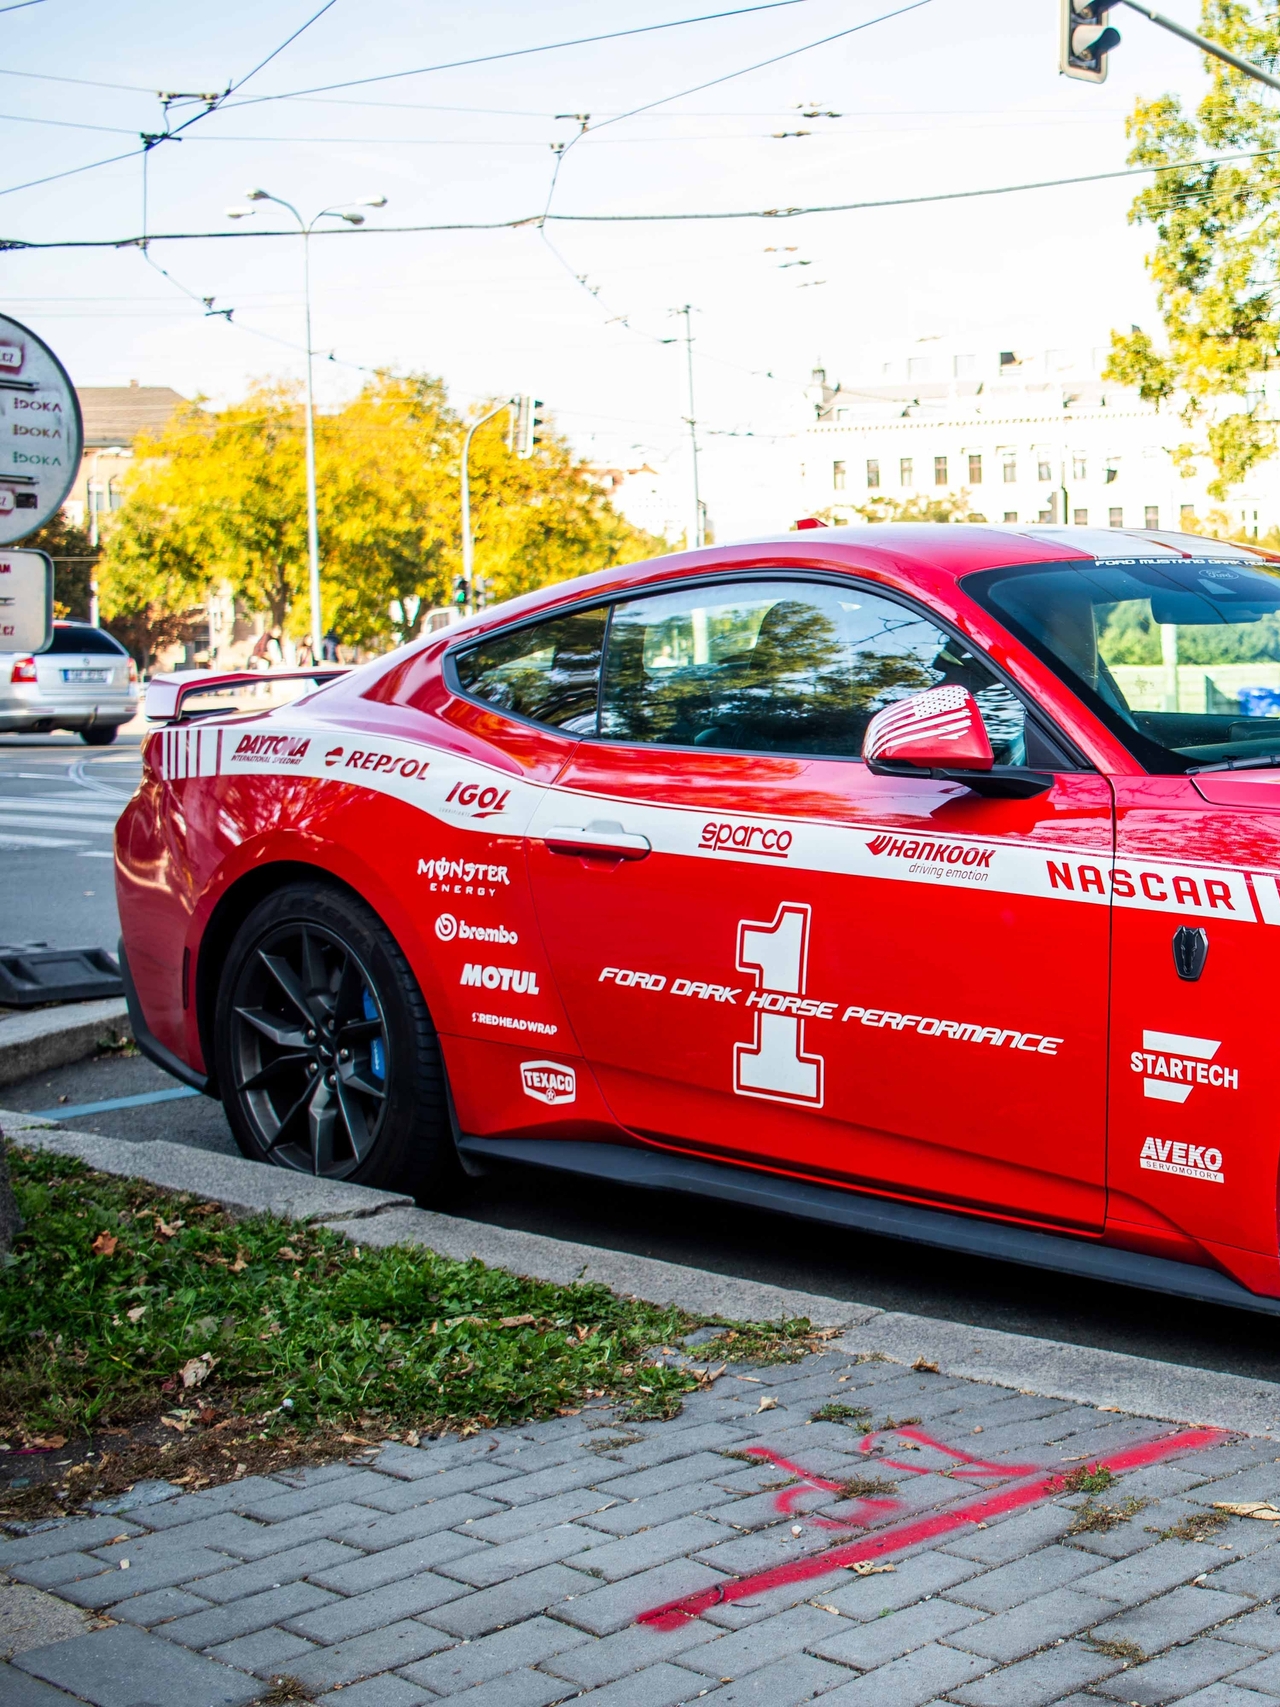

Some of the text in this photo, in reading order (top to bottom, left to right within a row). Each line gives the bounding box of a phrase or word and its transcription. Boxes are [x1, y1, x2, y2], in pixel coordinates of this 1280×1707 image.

[1095, 559, 1136, 567] FORD
[231, 754, 302, 766] INTERNATIONAL SPEEDWAY
[235, 734, 311, 758] DAYTONA
[345, 750, 430, 781] REPSOL
[445, 781, 511, 811] IGOL
[701, 821, 793, 852] sparco
[417, 857, 510, 886] MONSTER
[908, 862, 989, 882] driving emotion
[1046, 860, 1236, 911] NASCAR
[430, 882, 496, 897] ENERGY
[458, 920, 519, 945] brembo
[460, 963, 540, 995] MOTUL
[598, 967, 1064, 1055] FORD DARK HORSE PERFORMANCE
[733, 901, 824, 1108] 1
[524, 1071, 573, 1092] TEXACO
[1130, 1051, 1239, 1090] STARTECH
[1140, 1136, 1223, 1171] AVEKO
[1146, 1160, 1219, 1181] SERVOMOTORY
